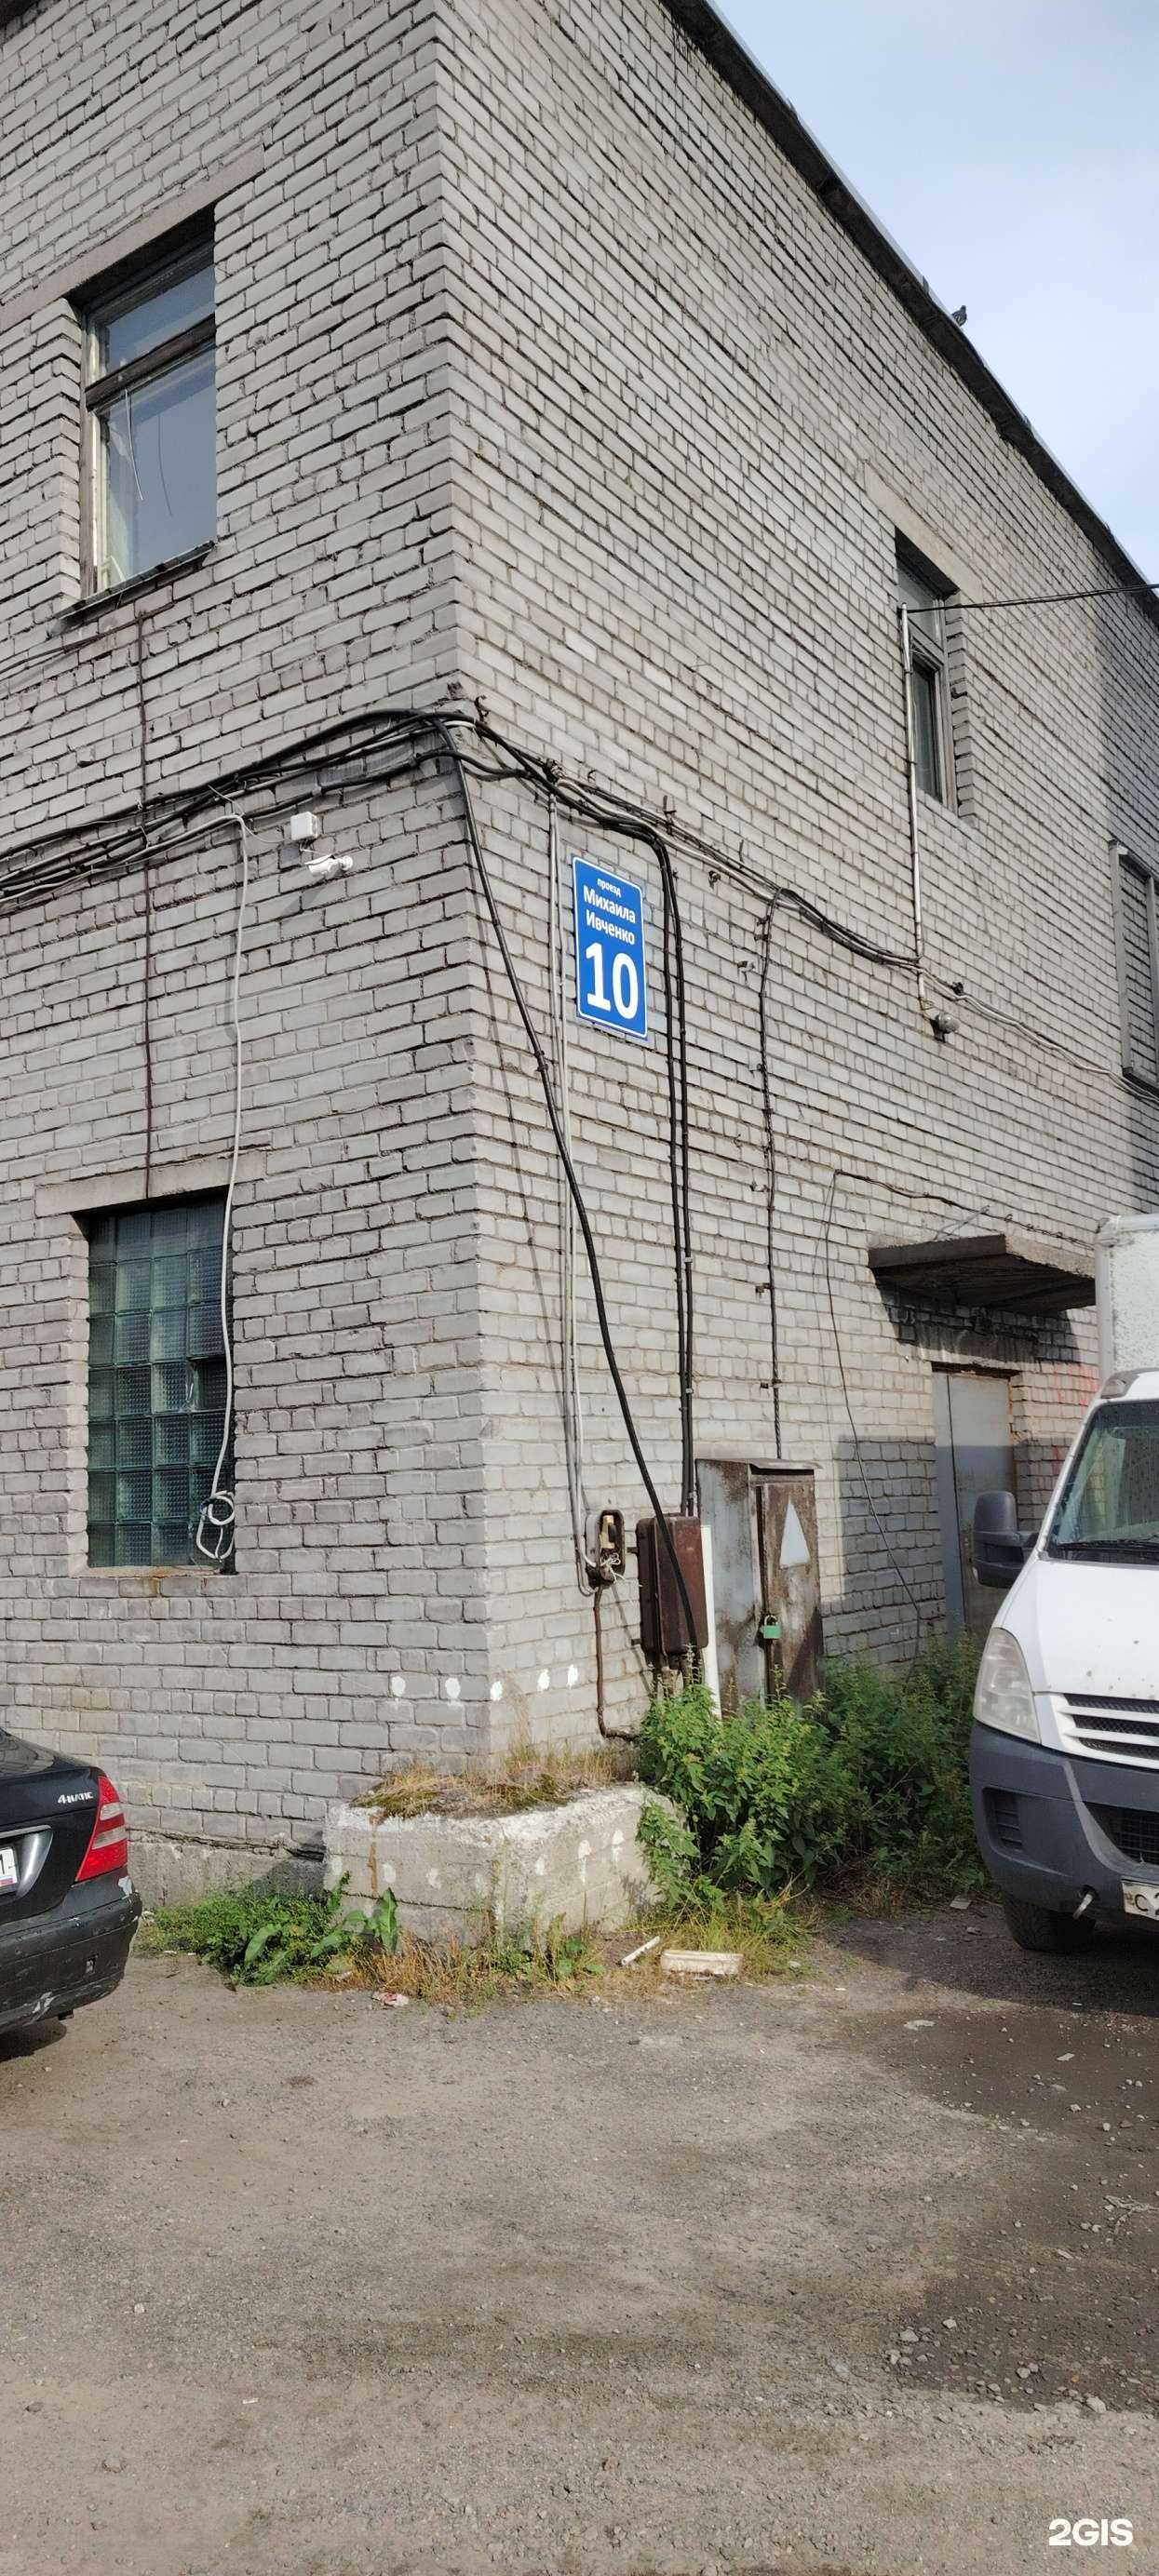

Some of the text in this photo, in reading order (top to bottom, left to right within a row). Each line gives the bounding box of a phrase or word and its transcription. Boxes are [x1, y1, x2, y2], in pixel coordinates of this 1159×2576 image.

[584, 885, 636, 923] Михаила
[597, 879, 621, 898] проезд
[586, 908, 635, 946] Ивченко
[586, 942, 639, 1019] 10
